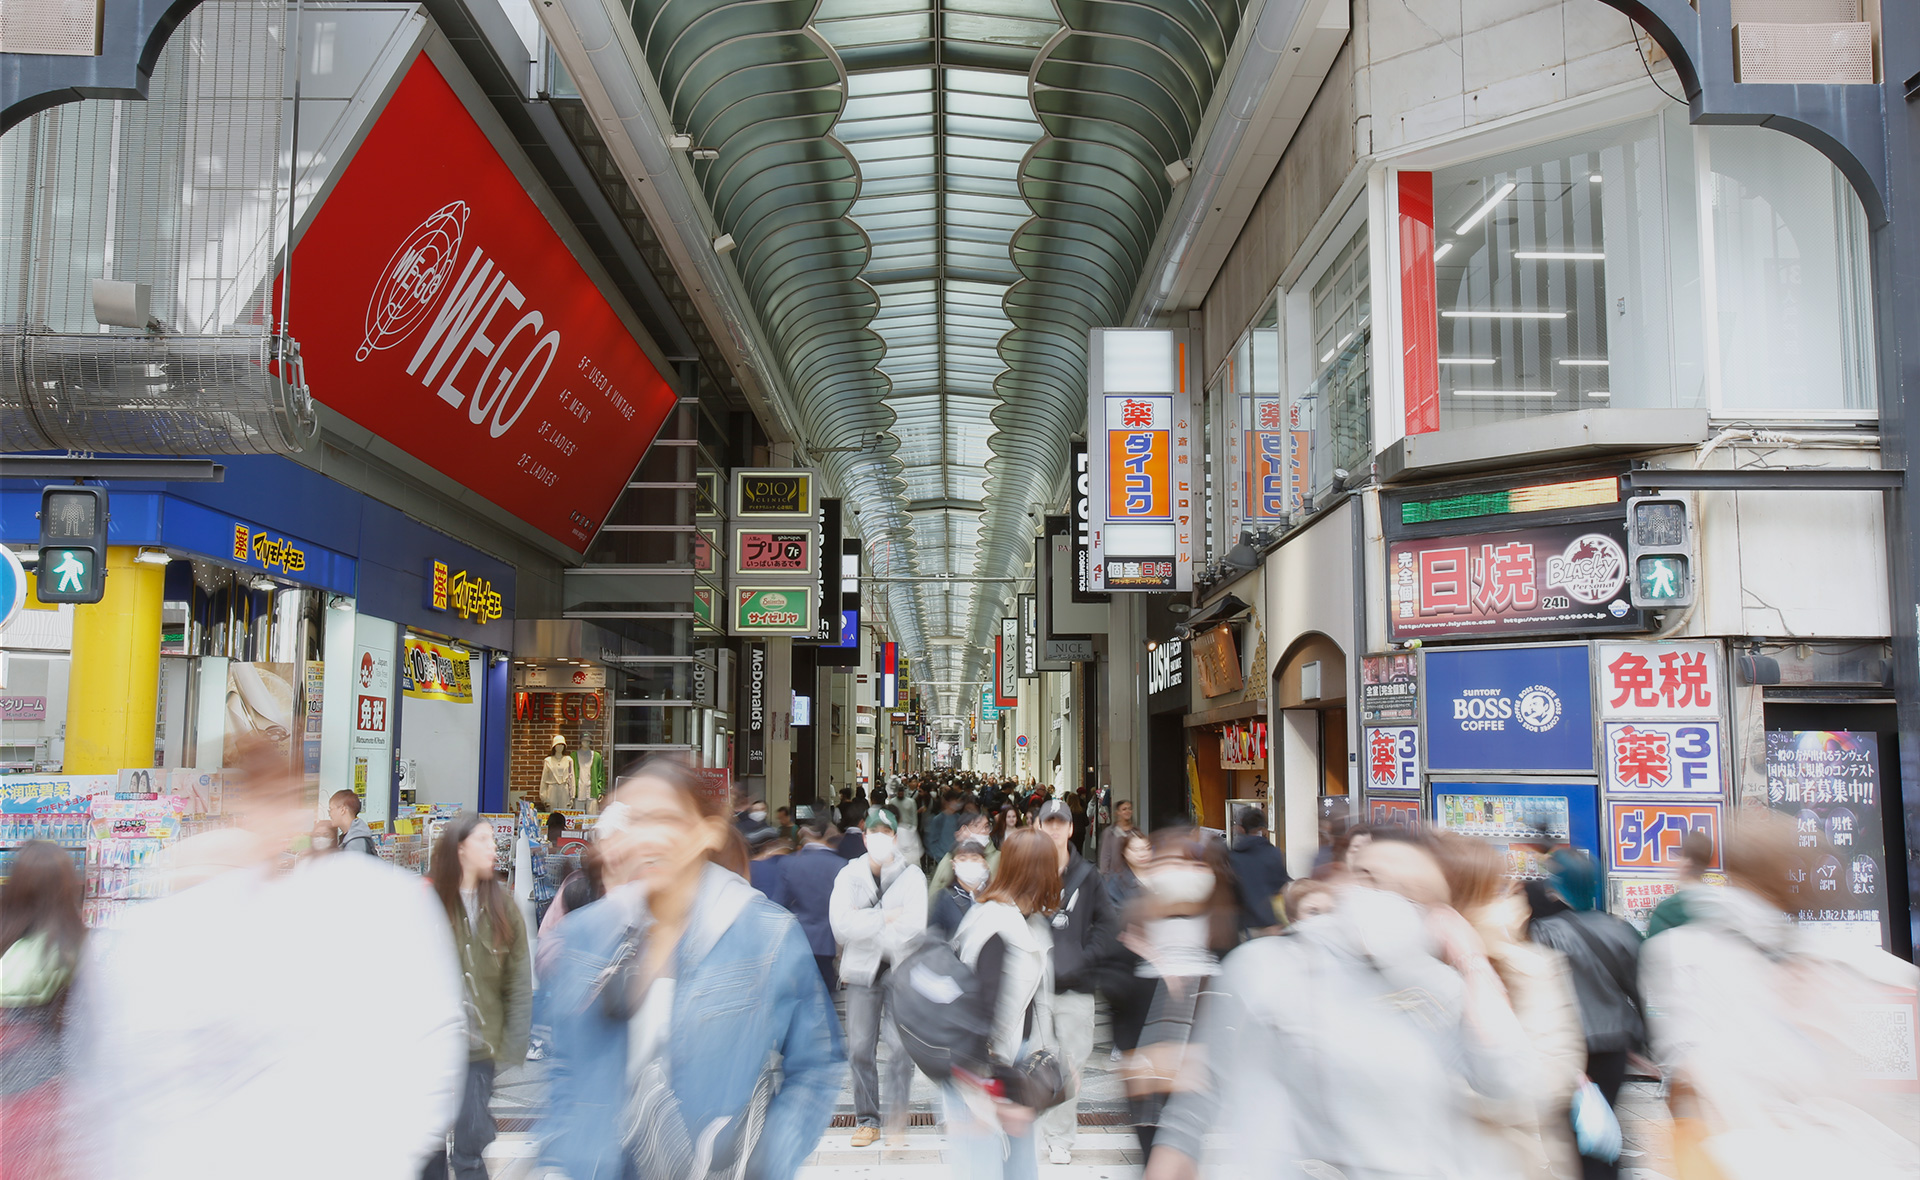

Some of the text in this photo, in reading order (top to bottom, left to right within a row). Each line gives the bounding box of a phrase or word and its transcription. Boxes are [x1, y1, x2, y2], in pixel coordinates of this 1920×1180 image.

[406, 246, 560, 438] WEGO
[604, 385, 613, 397] &
[610, 389, 636, 421] VINTAGE
[1120, 399, 1154, 428] 薬
[1125, 432, 1153, 514] ダイコク
[756, 482, 788, 496] DIO
[1178, 481, 1190, 563] ヒロタビル
[234, 525, 248, 560] 薬
[1094, 531, 1102, 548] 1F
[253, 532, 304, 574] マツモトキヨシ
[747, 541, 800, 560] プリ 7F
[746, 560, 794, 568] いっぱいあるで
[1093, 564, 1103, 582] 4F
[1107, 561, 1173, 578] 個室日焼
[434, 560, 448, 611] 薬
[1398, 551, 1414, 618] 完全個室
[1419, 541, 1538, 617] 日焼
[1572, 581, 1616, 591] Personal
[451, 570, 502, 624] マツモトキヨシ
[1543, 596, 1569, 610] 24h
[748, 611, 799, 625] サイゼリヤ
[1005, 621, 1016, 694] ジャパンライフ
[1055, 643, 1083, 653] NICE
[1149, 642, 1170, 695] LUSH
[751, 649, 763, 731] McDonald's
[1608, 651, 1712, 709] 免税
[1518, 685, 1534, 699] BOSS
[1534, 684, 1557, 698] COFFEE
[361, 698, 384, 730] 免税
[1453, 698, 1513, 719] BOSS
[1514, 699, 1524, 723] COFFEE
[1554, 697, 1562, 715] BOSS
[1461, 720, 1505, 731] COFFEE
[1540, 715, 1560, 732] COFFEE
[1369, 728, 1399, 786] 薬
[1399, 729, 1416, 786] 3F
[1612, 726, 1672, 788] 薬
[1675, 727, 1712, 788] 3F
[1767, 763, 1875, 778] 国内最大規模のコンテスト
[1769, 778, 1874, 805] 参加者募集中!!
[497, 825, 512, 833] 278
[1797, 816, 1853, 833] 女性 男性
[1798, 833, 1853, 848] 部門 部門
[1816, 864, 1837, 878] ペア
[1625, 884, 1676, 897] 未経験者
[1819, 879, 1837, 891] 部門
